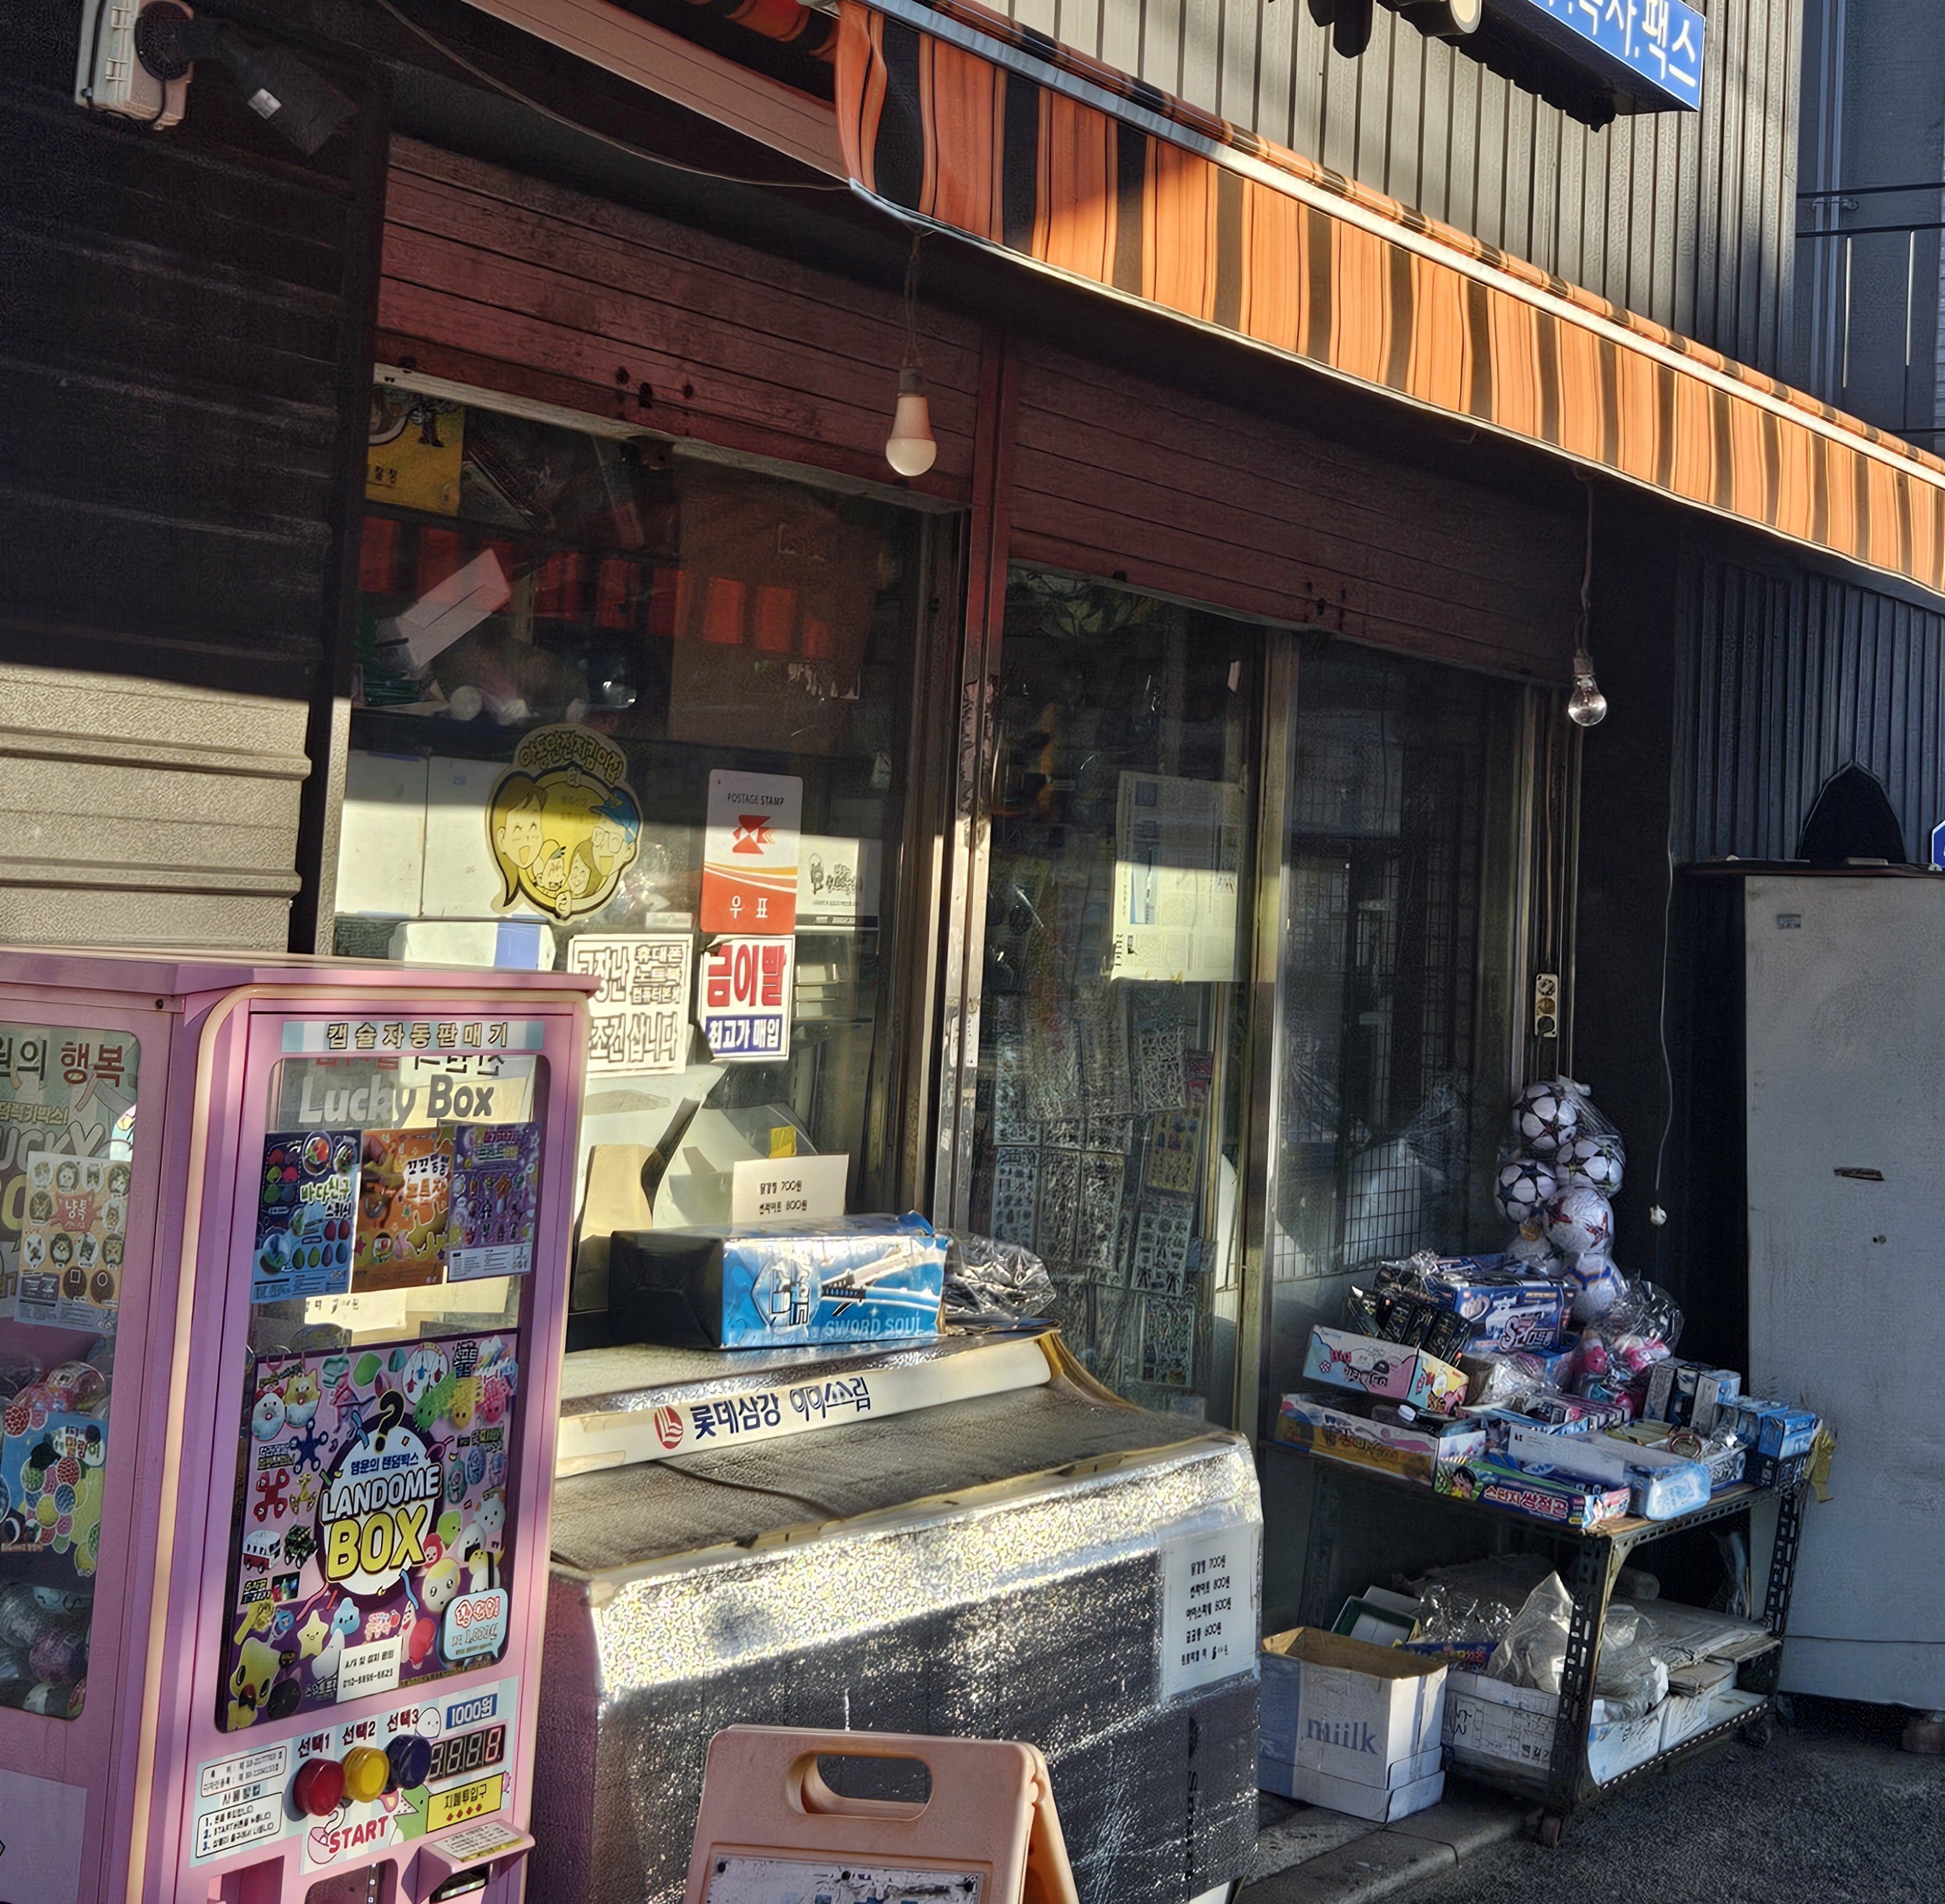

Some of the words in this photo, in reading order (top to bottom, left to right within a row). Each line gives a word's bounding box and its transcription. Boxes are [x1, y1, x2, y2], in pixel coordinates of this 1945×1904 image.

[727, 793, 758, 805] POSTAGE
[761, 796, 784, 805] STAMP
[635, 944, 684, 964] 휴대폰
[633, 965, 682, 985] 노트북
[708, 944, 786, 1007] 금이빨
[588, 1013, 626, 1063] 조건
[628, 1012, 678, 1063] 삽니다
[708, 1019, 751, 1049] 최고가
[753, 1018, 780, 1048] 매입
[61, 1041, 125, 1088] 행복
[298, 1074, 417, 1128] Lucky
[427, 1074, 494, 1119] Box
[824, 1318, 881, 1336] SWORD
[885, 1316, 925, 1334] SOUL
[690, 1393, 781, 1440] 롯데삼강
[321, 1464, 441, 1525] LANDOME
[326, 1505, 427, 1582] BOX
[387, 1708, 419, 1733] 선택3
[451, 1697, 493, 1727] 1000원
[298, 1733, 330, 1758] 선택1
[343, 1720, 376, 1746] 선택2
[329, 1815, 389, 1854] START
